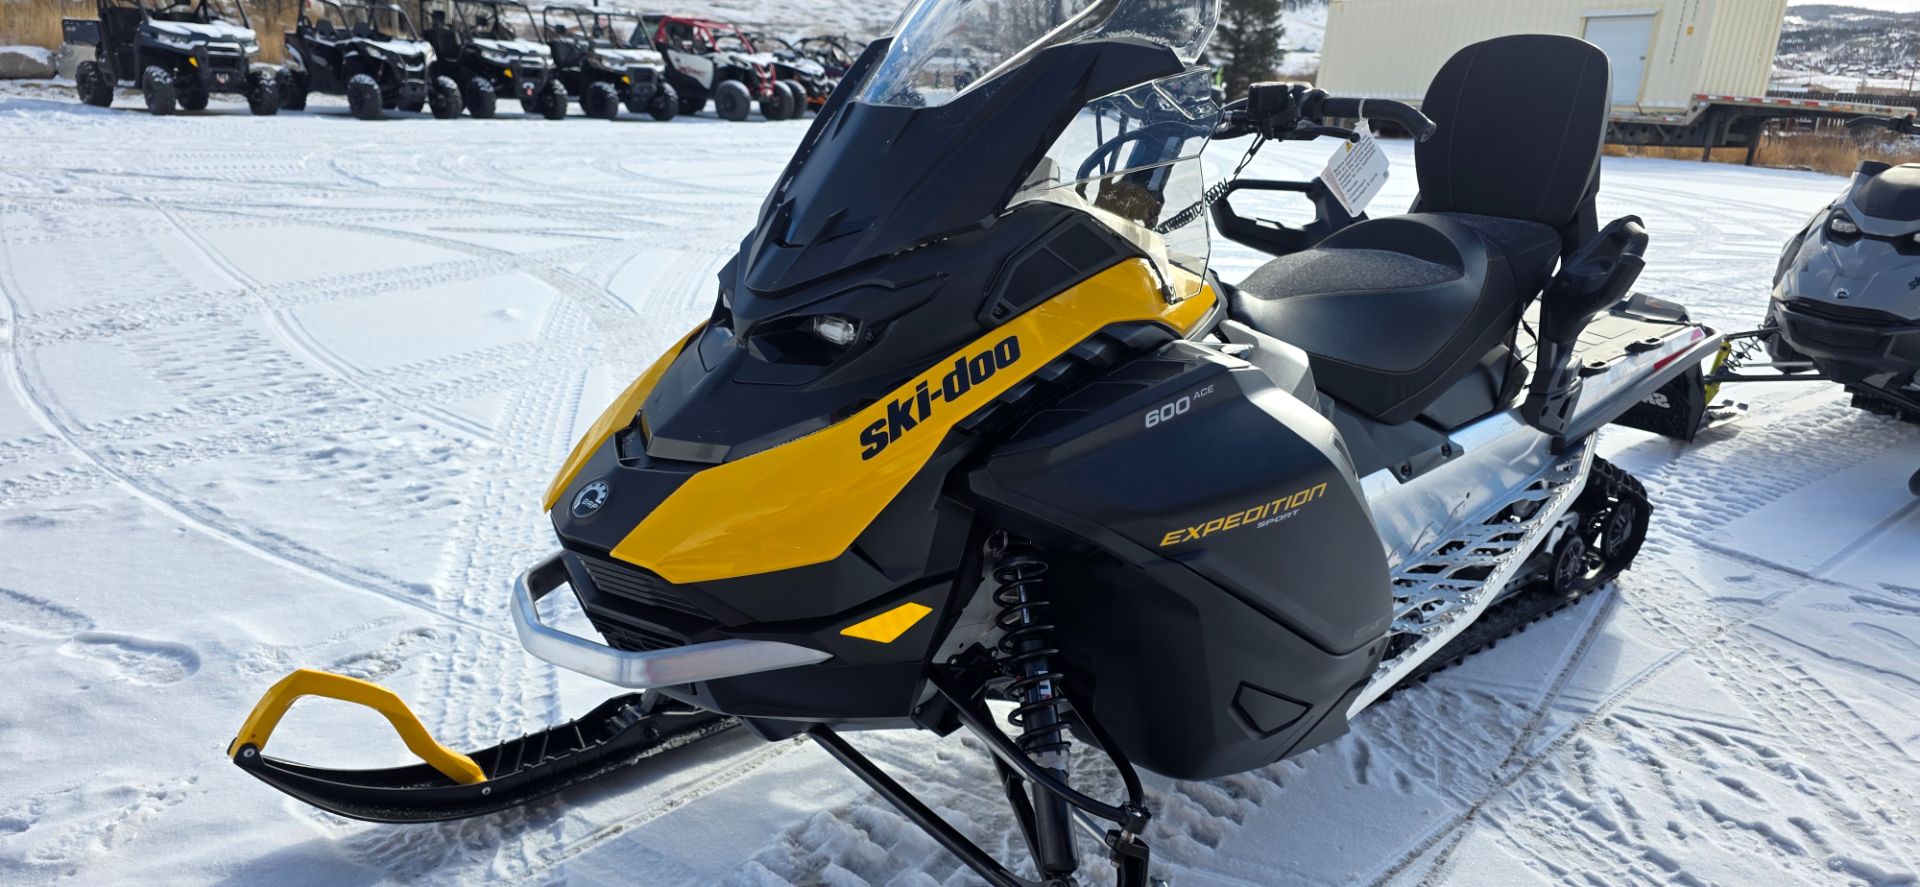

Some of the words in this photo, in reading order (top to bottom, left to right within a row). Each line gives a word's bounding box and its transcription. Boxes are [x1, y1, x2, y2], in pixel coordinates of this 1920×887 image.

[1145, 396, 1190, 428] 600
[1193, 384, 1214, 400] ACE
[582, 498, 598, 509] BRP
[1160, 482, 1328, 546] EXPEDITION
[1257, 508, 1300, 529] SPORT
